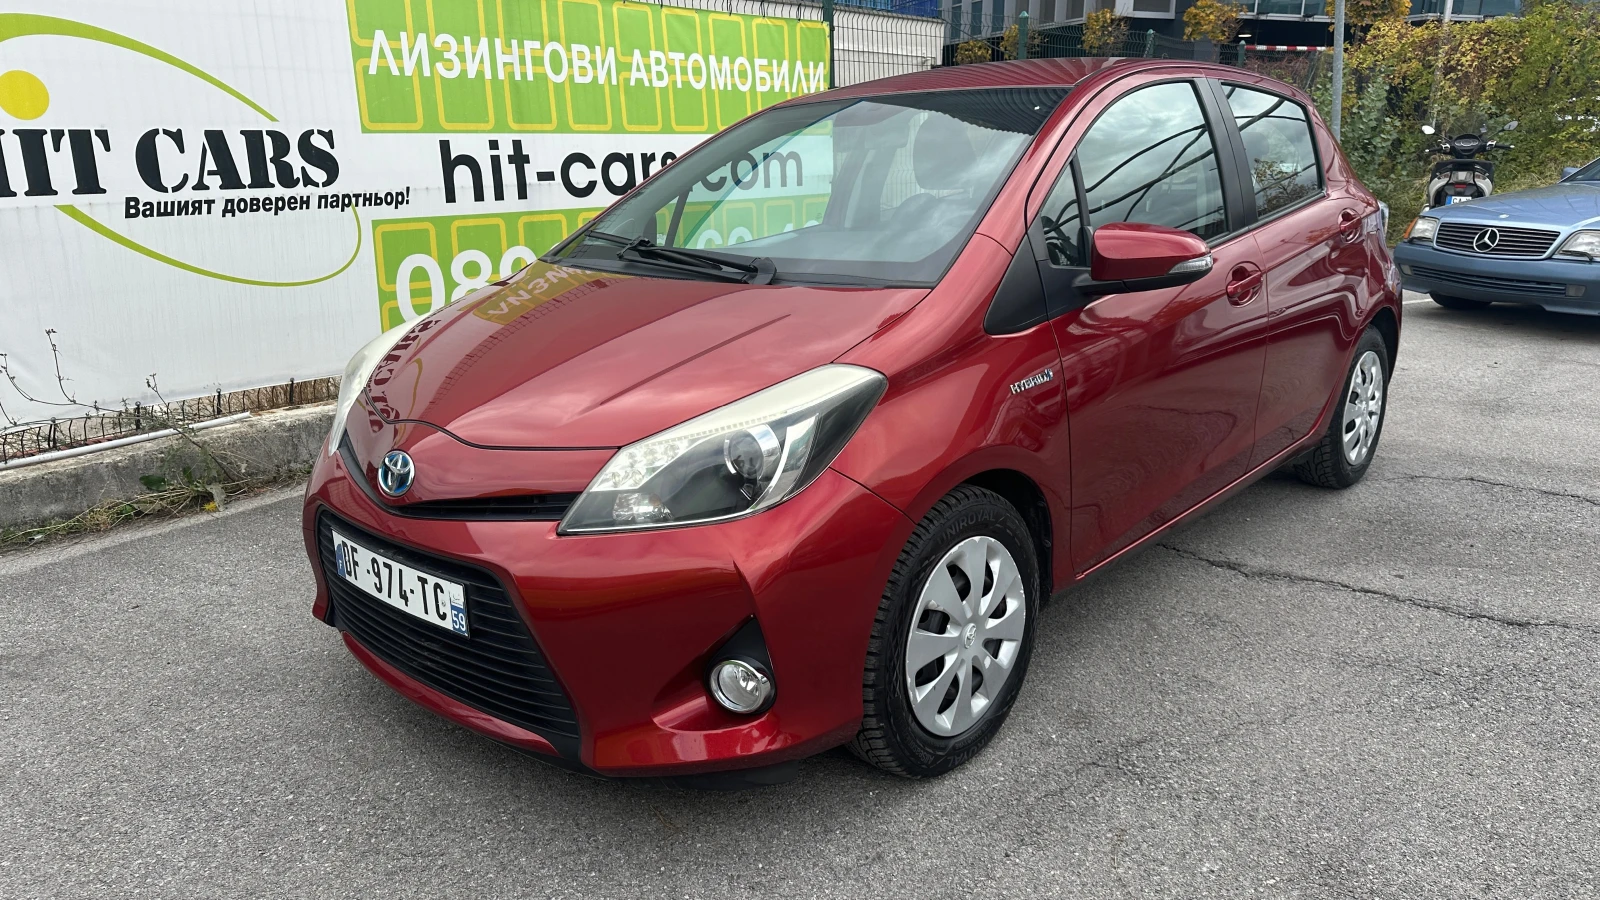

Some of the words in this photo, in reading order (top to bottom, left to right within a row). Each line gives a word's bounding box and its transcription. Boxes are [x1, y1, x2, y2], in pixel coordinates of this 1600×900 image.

[368, 29, 618, 86] ЛИЗИНГОВИ
[630, 49, 826, 94] АВТОМОБИЛИ
[135, 128, 340, 194] CARS
[124, 196, 215, 219] Вашият
[222, 193, 310, 217] доверен
[317, 186, 411, 210] партньор!
[1010, 371, 1048, 394] HYBRID
[936, 507, 997, 545] UNIROYAL
[451, 609, 466, 632] 59
